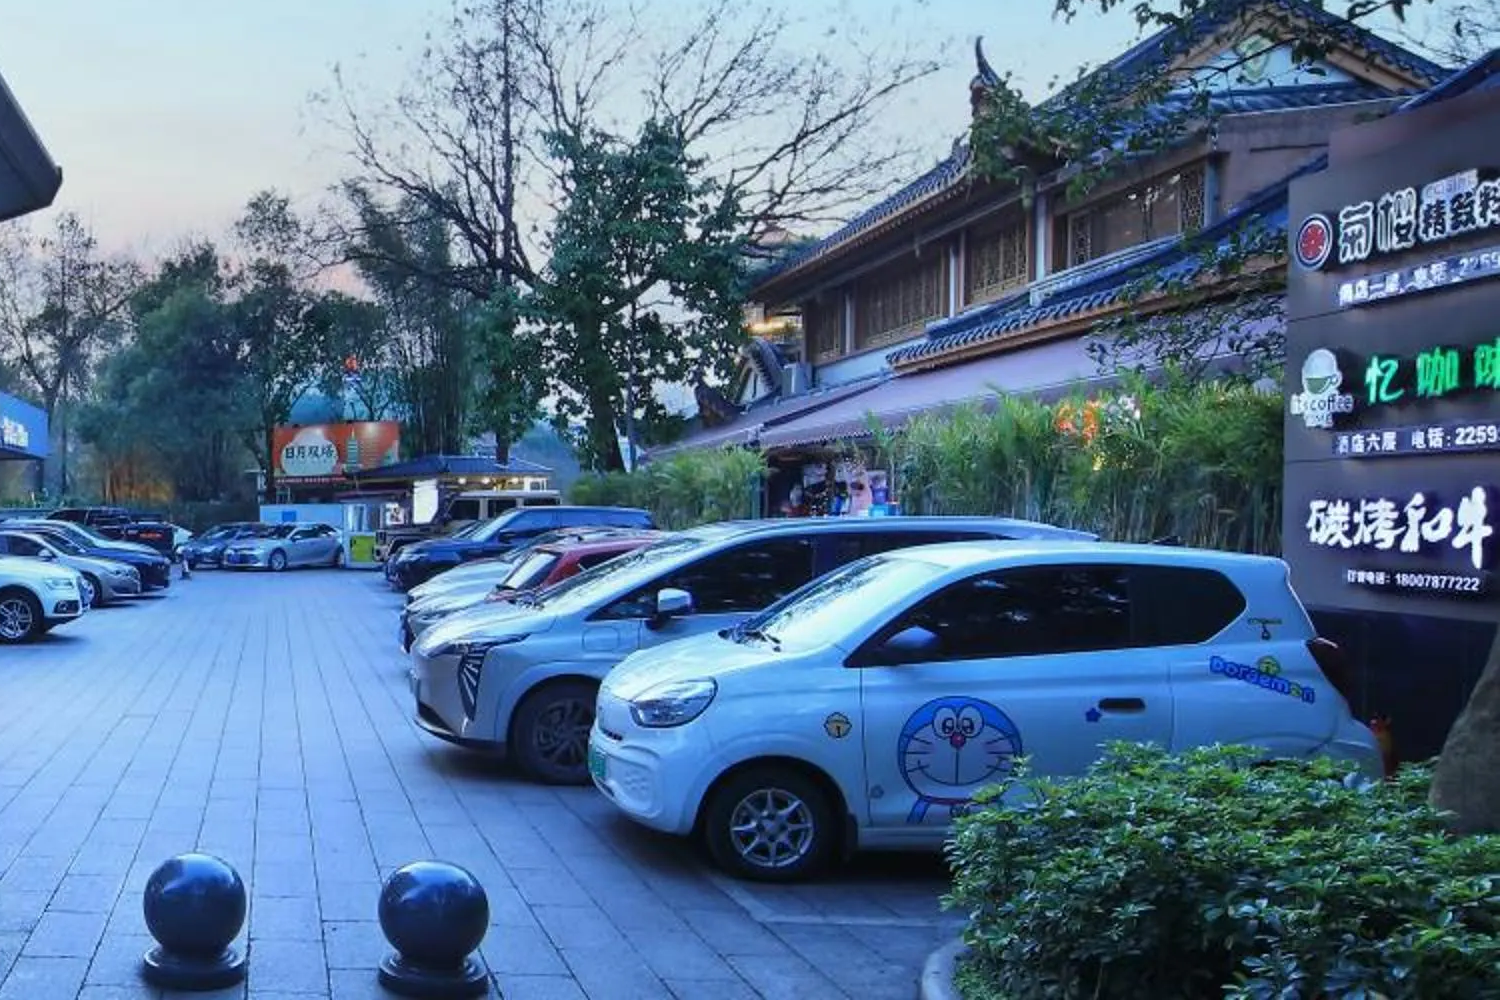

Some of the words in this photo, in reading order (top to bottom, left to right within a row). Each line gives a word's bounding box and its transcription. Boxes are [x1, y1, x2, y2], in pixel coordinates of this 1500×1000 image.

[285, 444, 334, 459] 日月双塔
[1336, 431, 1397, 454] 酒店六层
[1306, 486, 1493, 570] 碳烤和牛
[1210, 656, 1315, 703] Doraemon
